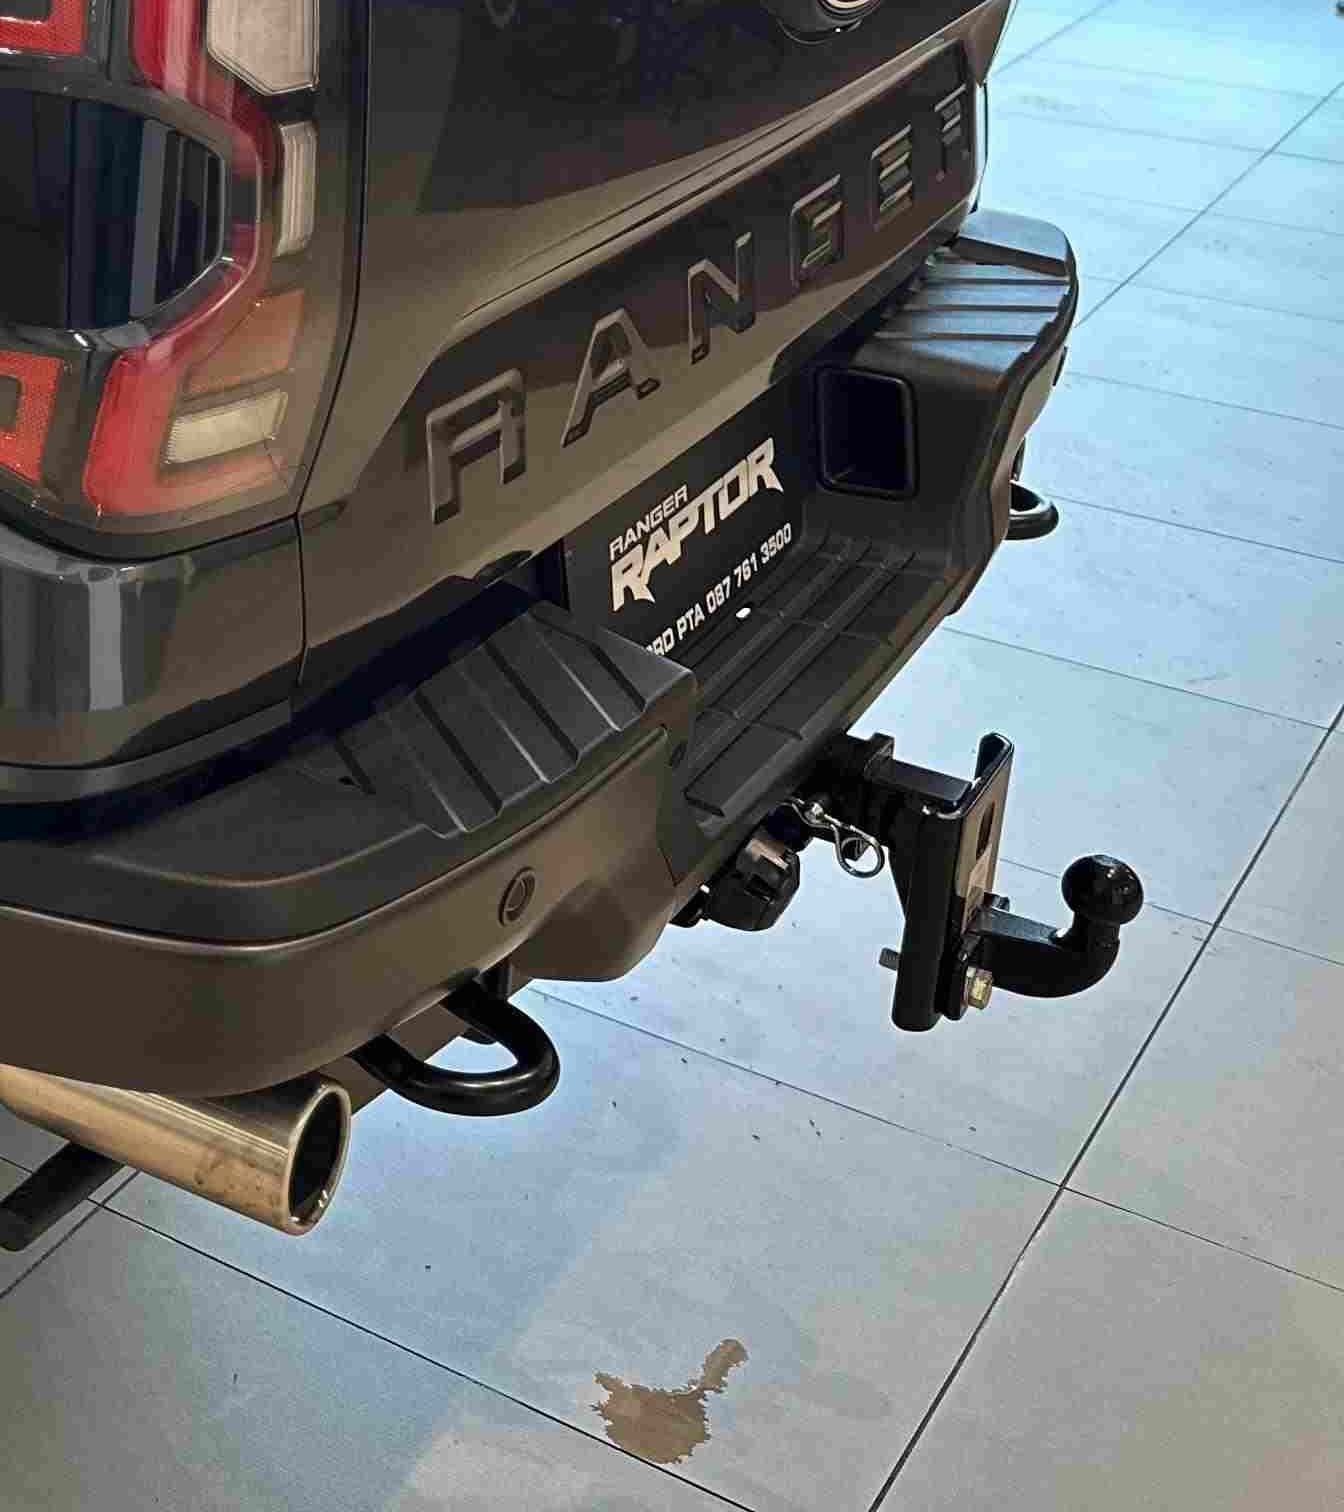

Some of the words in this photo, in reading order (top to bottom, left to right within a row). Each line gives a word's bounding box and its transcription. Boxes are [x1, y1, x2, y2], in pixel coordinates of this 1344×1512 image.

[426, 85, 969, 525] RANGER
[609, 485, 688, 560] RANGER
[611, 437, 784, 612] RAPTOR
[645, 627, 676, 657] RD
[676, 602, 706, 641] PTA
[705, 575, 732, 615] 087
[733, 552, 758, 588] 761
[760, 522, 792, 564] 3500
